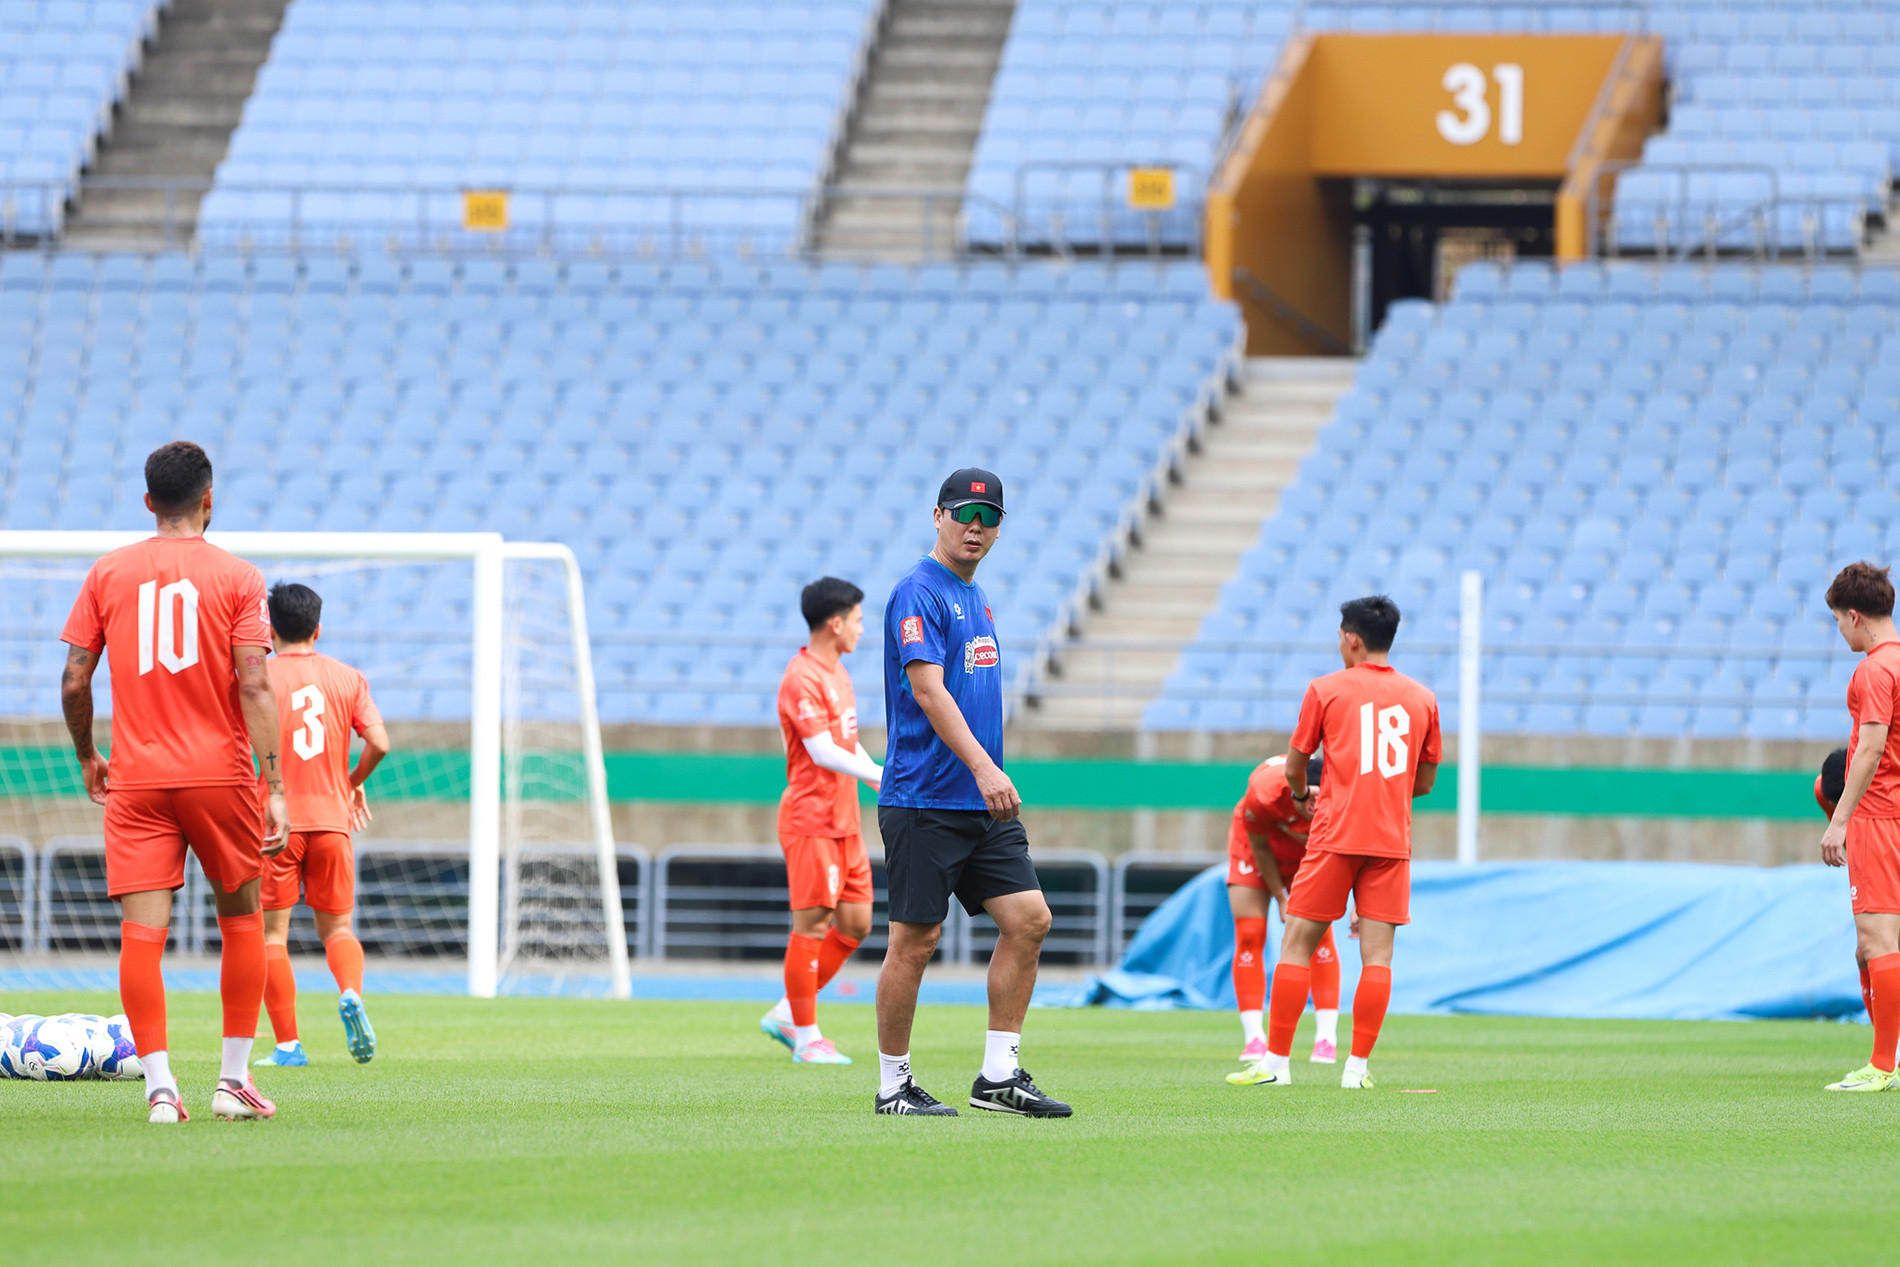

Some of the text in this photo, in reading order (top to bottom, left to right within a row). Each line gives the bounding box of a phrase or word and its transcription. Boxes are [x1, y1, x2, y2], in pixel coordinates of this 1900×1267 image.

[1435, 62, 1524, 146] 31
[138, 578, 199, 676] 10
[291, 684, 325, 761] 3
[1360, 702, 1410, 779] 18
